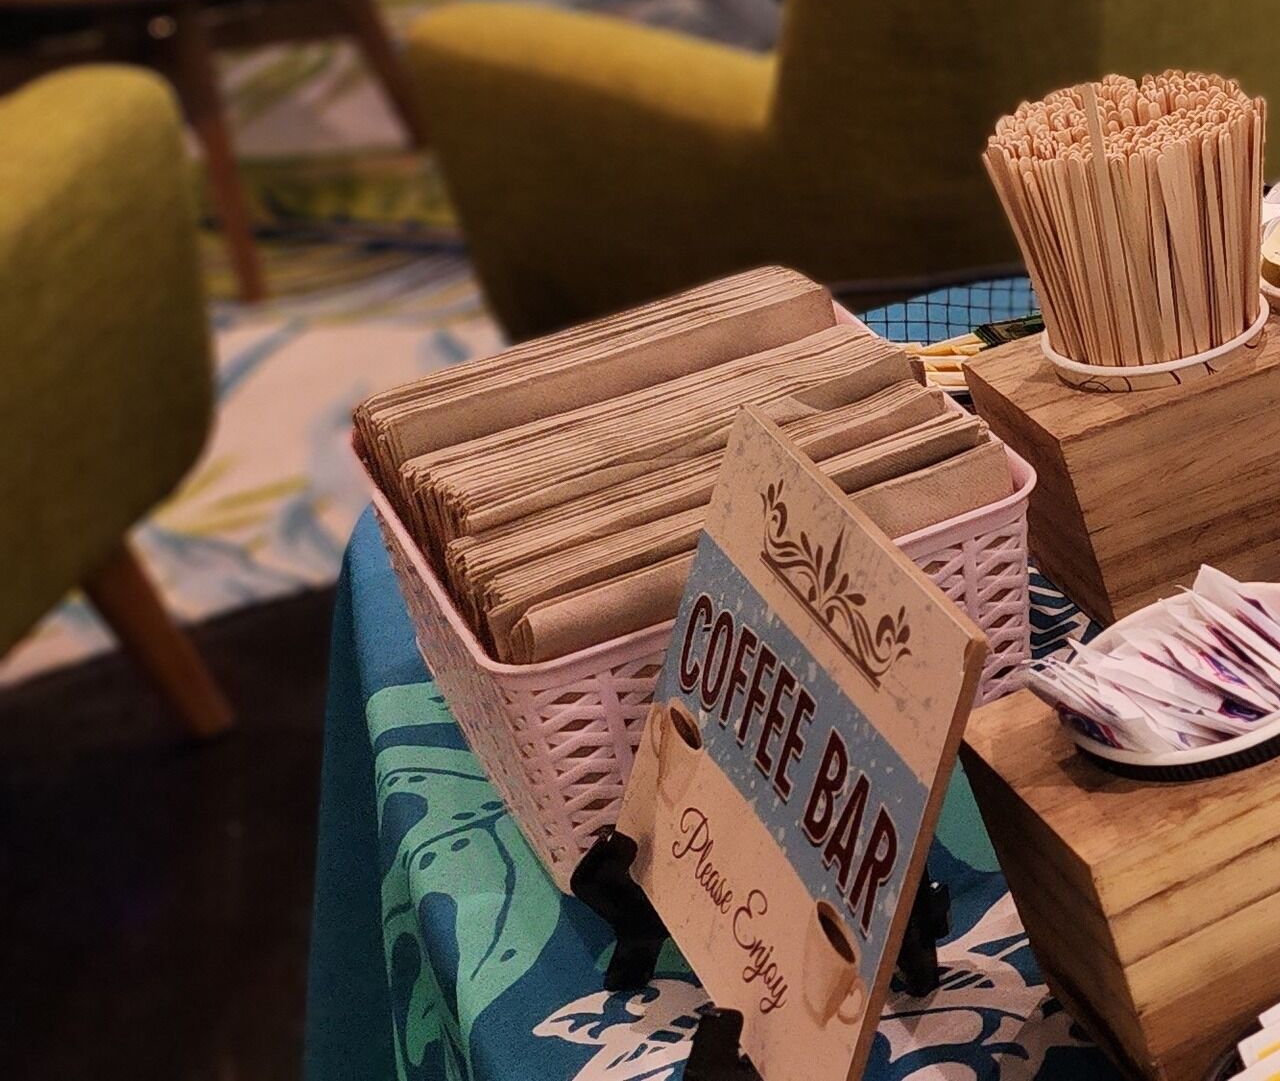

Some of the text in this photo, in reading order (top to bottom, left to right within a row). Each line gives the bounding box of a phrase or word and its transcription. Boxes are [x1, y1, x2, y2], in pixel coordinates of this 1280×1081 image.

[679, 594, 900, 935] COFFEE BAR
[672, 806, 790, 1013] Please Enjoy
